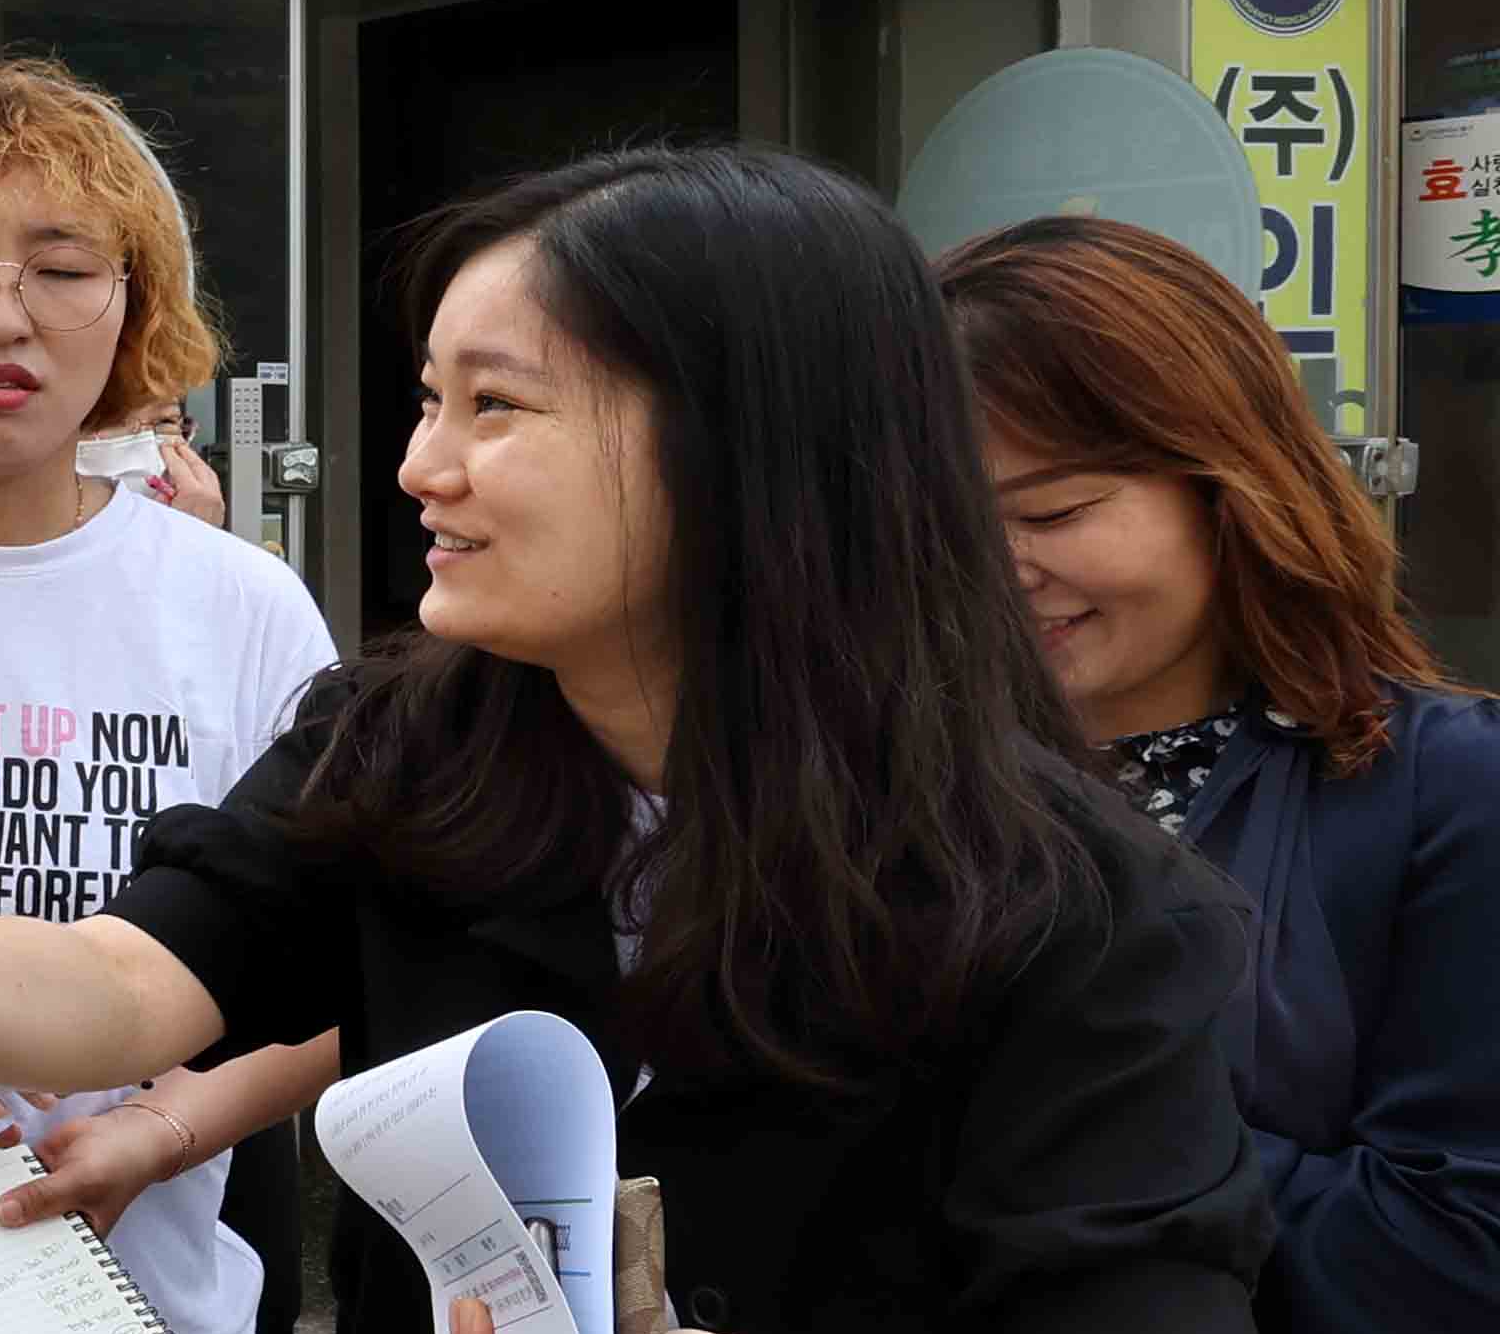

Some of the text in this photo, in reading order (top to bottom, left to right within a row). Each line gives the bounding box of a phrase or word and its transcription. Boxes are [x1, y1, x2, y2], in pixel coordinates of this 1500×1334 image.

[1419, 159, 1468, 201] 효
[21, 705, 77, 757] UP
[91, 711, 189, 768] NOW
[2, 757, 58, 810] DO
[75, 763, 158, 816] YOU
